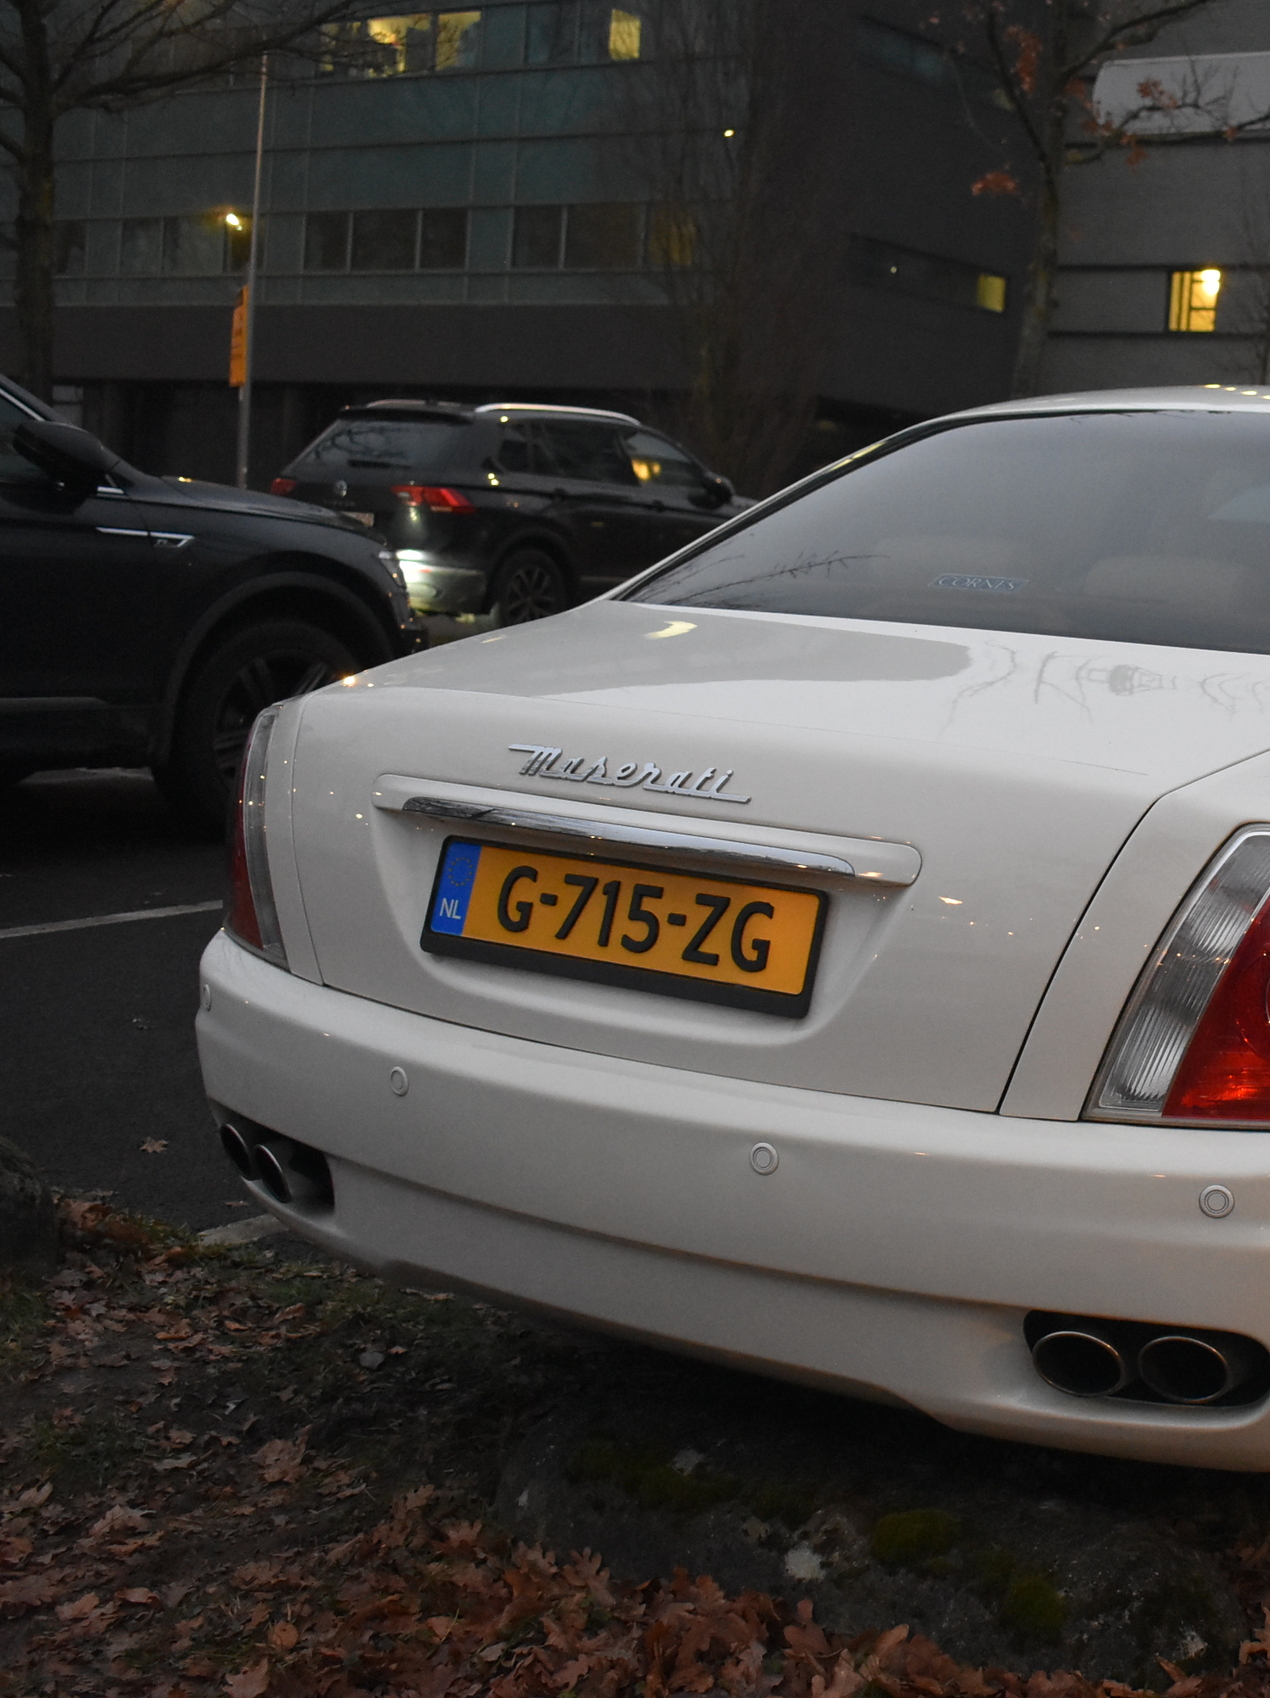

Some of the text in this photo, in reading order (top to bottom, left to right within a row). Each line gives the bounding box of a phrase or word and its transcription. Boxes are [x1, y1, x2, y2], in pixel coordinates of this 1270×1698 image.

[508, 743, 751, 803] Maserati
[439, 897, 462, 920] NL
[498, 865, 774, 973] G-715-ZG
